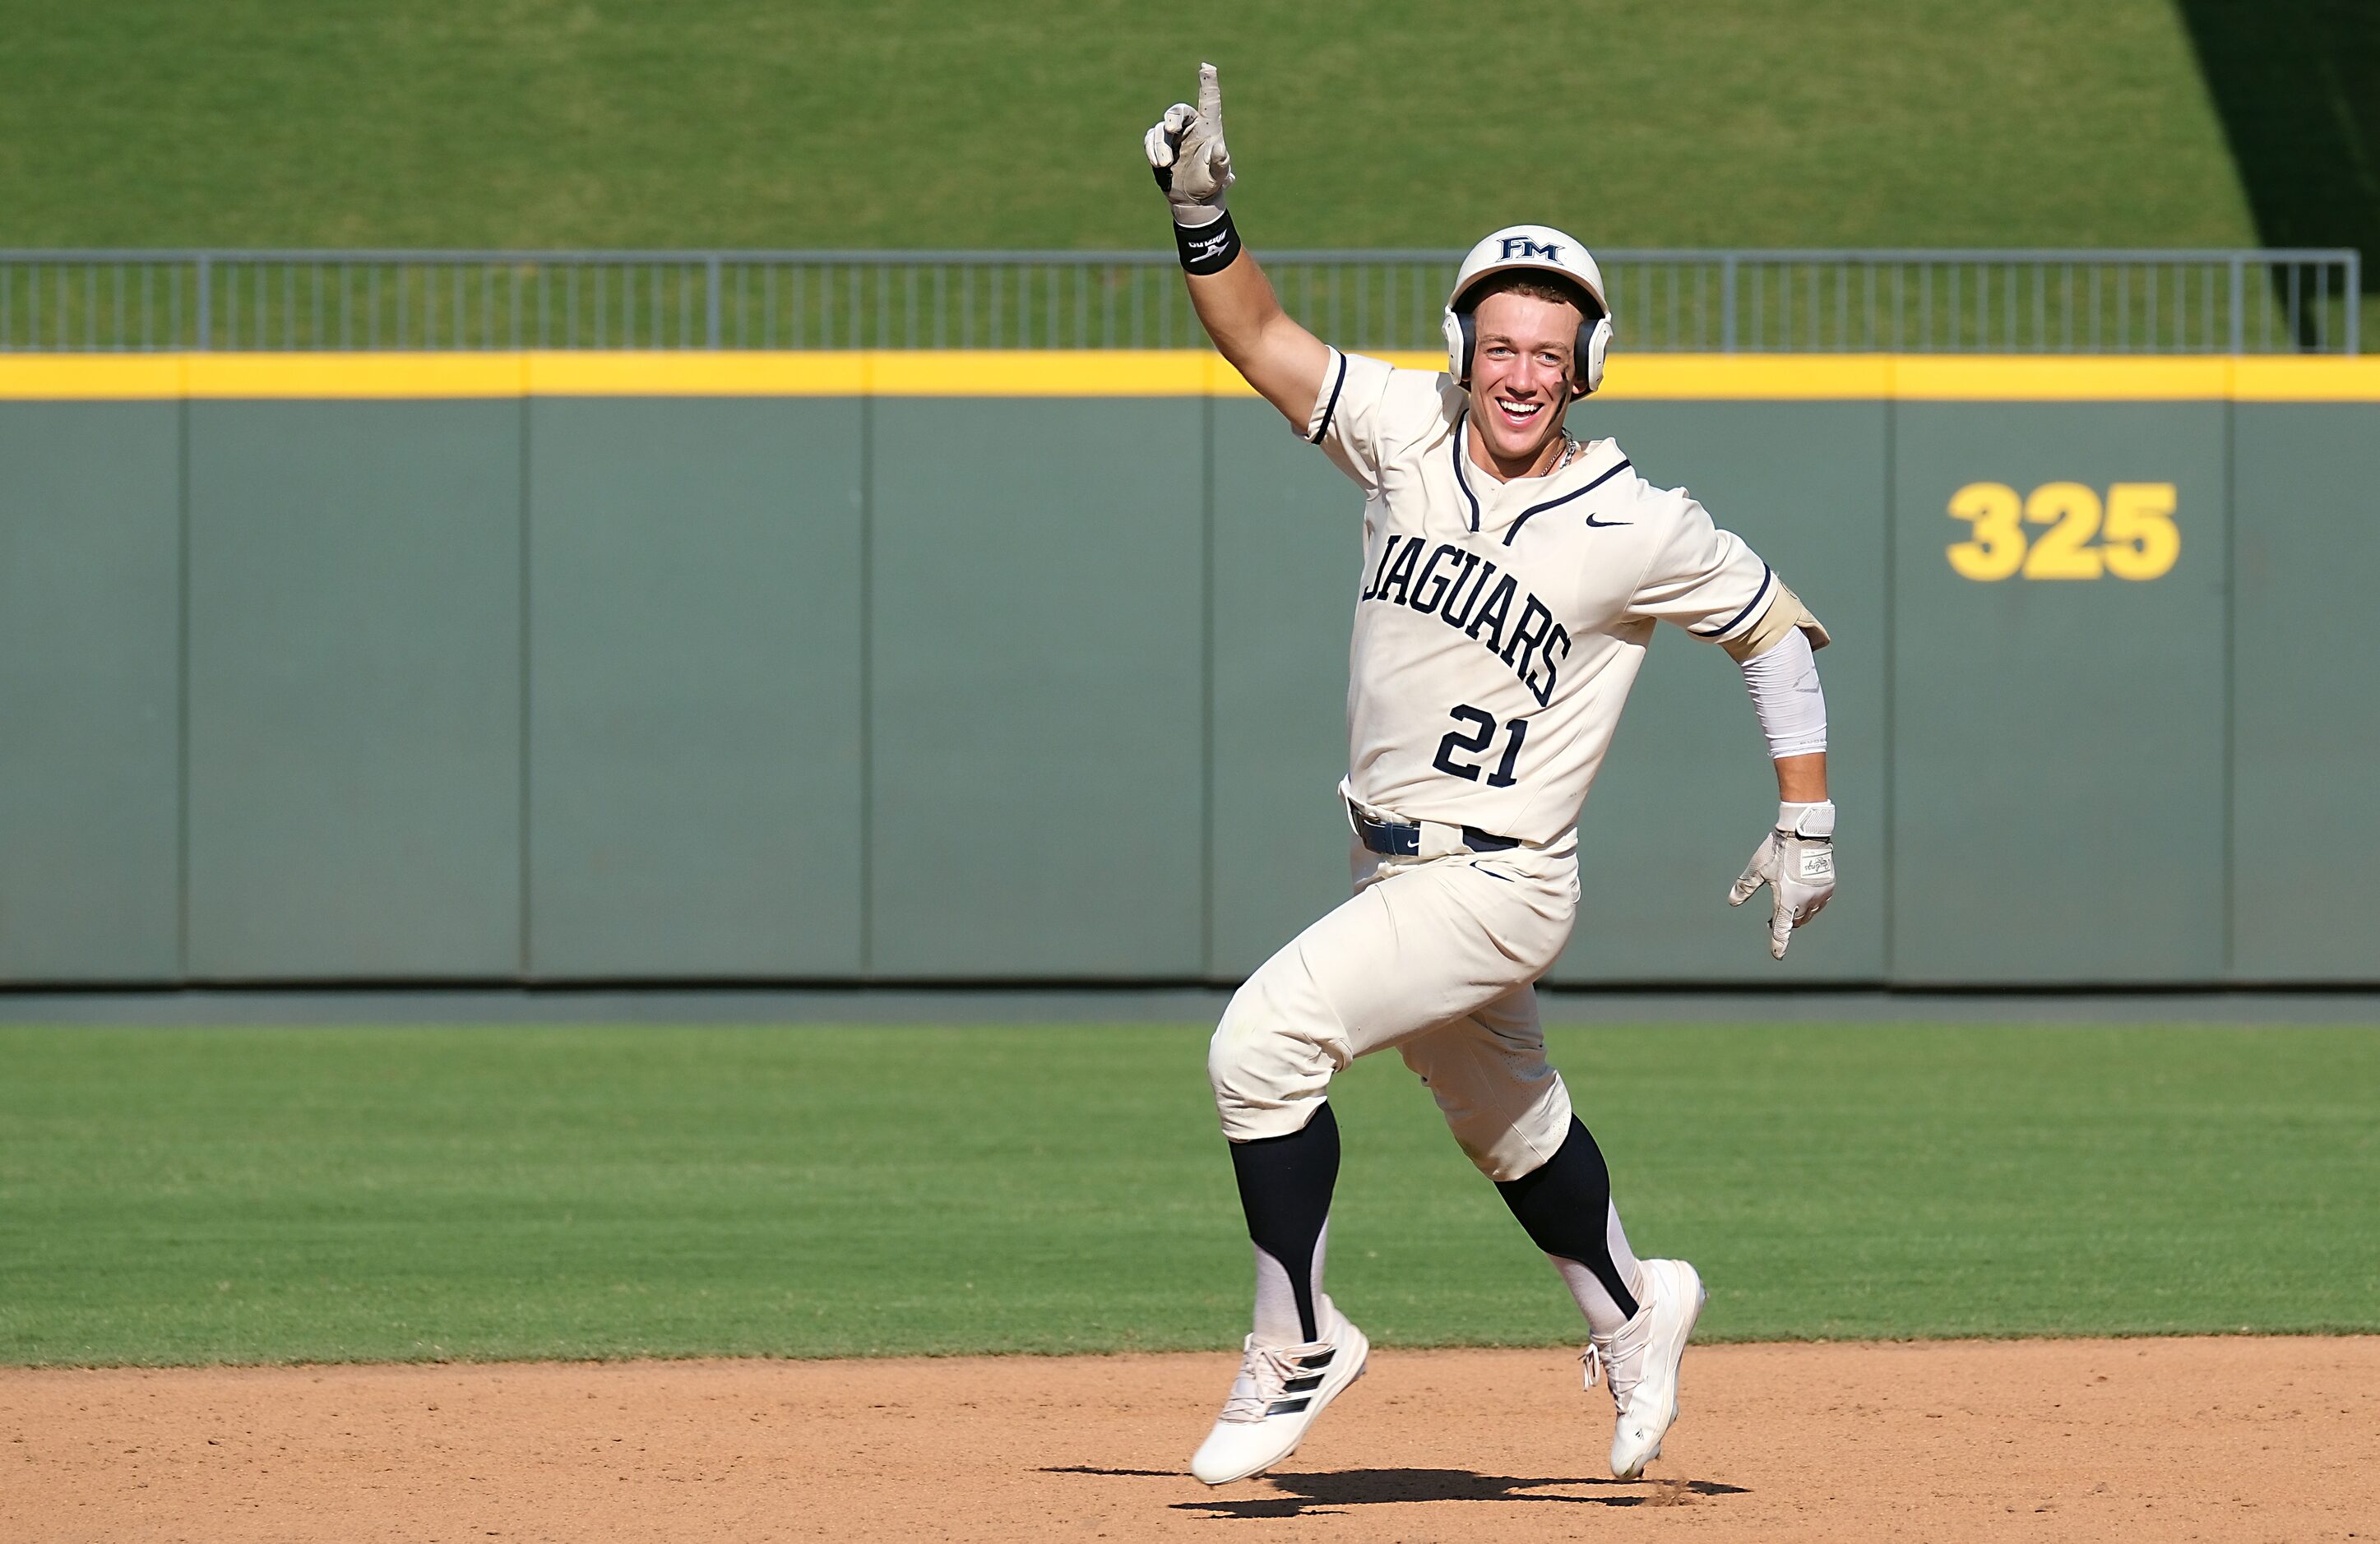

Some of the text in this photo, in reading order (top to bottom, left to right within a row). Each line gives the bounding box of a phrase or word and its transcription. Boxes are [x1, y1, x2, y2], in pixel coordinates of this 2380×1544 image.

[1497, 236, 1564, 265] FM
[1947, 482, 2180, 580] 325
[1362, 535, 1572, 707] JAGUARS
[1433, 704, 1528, 788] 21
